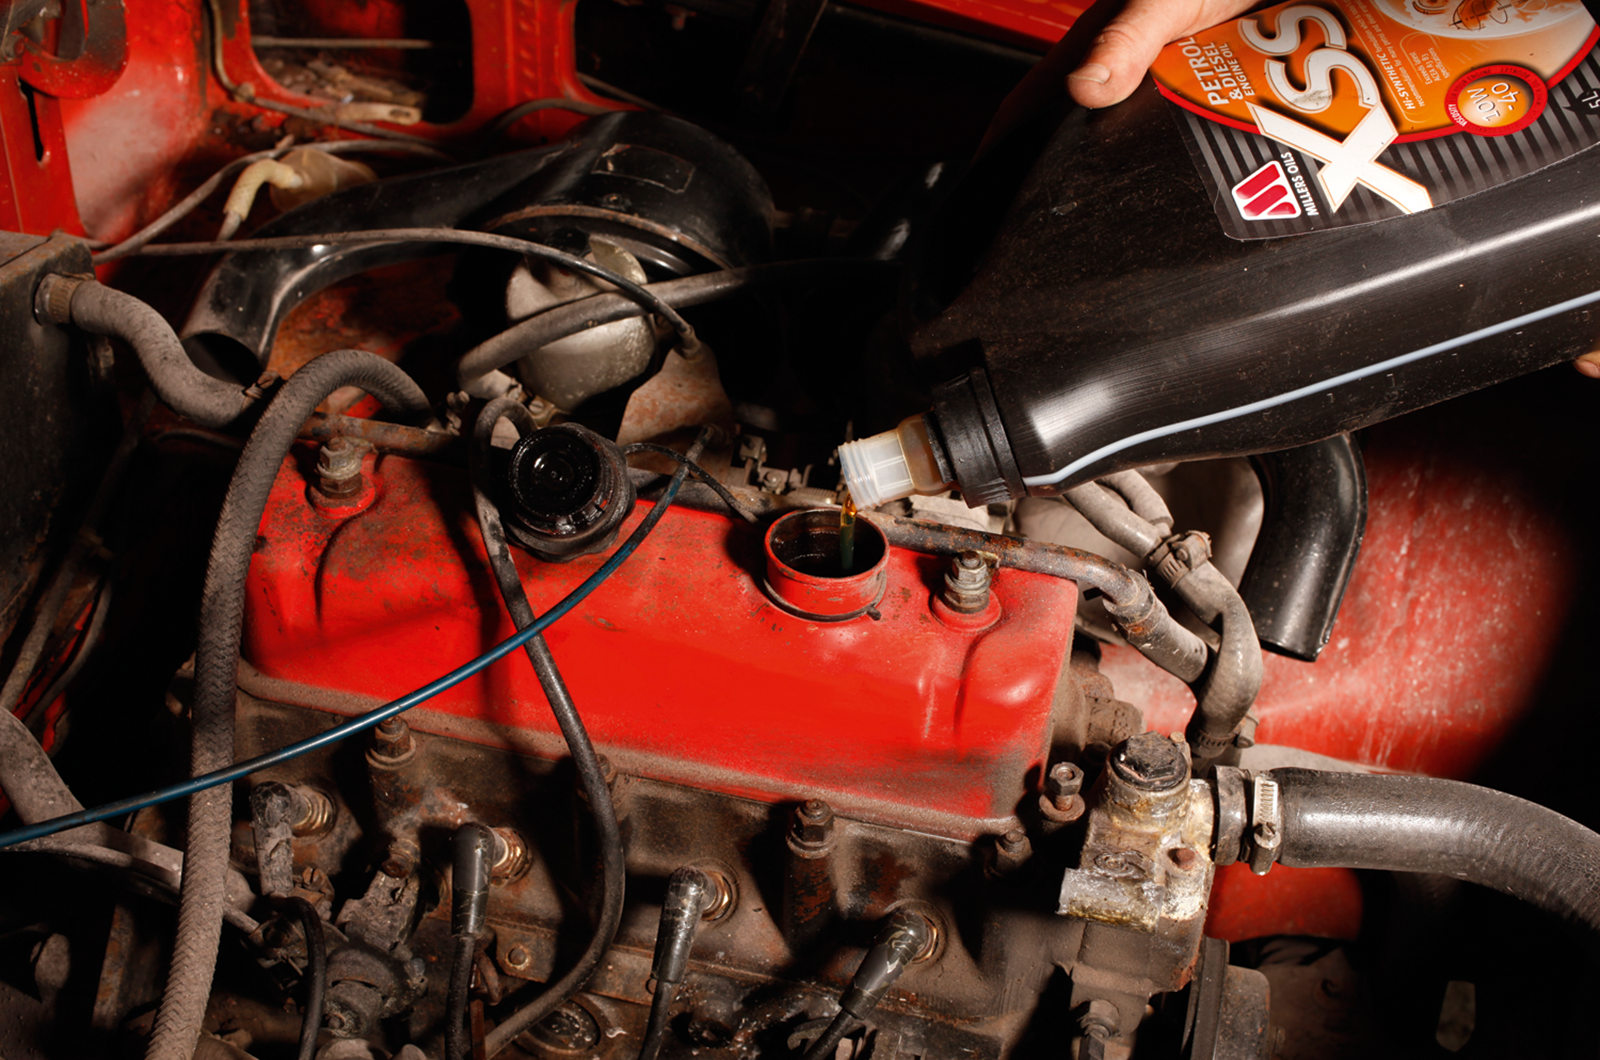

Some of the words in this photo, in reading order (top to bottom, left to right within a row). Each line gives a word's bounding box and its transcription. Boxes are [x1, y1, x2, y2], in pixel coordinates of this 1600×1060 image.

[1362, 12, 1377, 25] diesel
[1371, 24, 1382, 33] and
[1376, 32, 1392, 46] petrol
[1219, 42, 1233, 57] OIL
[1386, 45, 1398, 59] many
[1409, 51, 1422, 66] latest
[1420, 52, 1430, 62] B3
[1177, 36, 1230, 105] PETROL
[1393, 58, 1403, 67] for
[1425, 60, 1434, 69] A3
[1426, 46, 1451, 80] specifications
[1227, 58, 1256, 96] ENGINE
[1416, 64, 1434, 85] Exceeds
[1427, 67, 1442, 82] ACEA
[1499, 66, 1530, 78] BOOKLET
[1397, 66, 1426, 107] recommendation
[1447, 102, 1468, 127] VISCOSITY
[1466, 68, 1490, 81] ENGINE
[1466, 86, 1501, 123] 10W
[1490, 80, 1519, 112] -40
[1238, 4, 1433, 214] XSS
[1280, 151, 1300, 175] OILS
[1290, 174, 1320, 217] MILLERS
